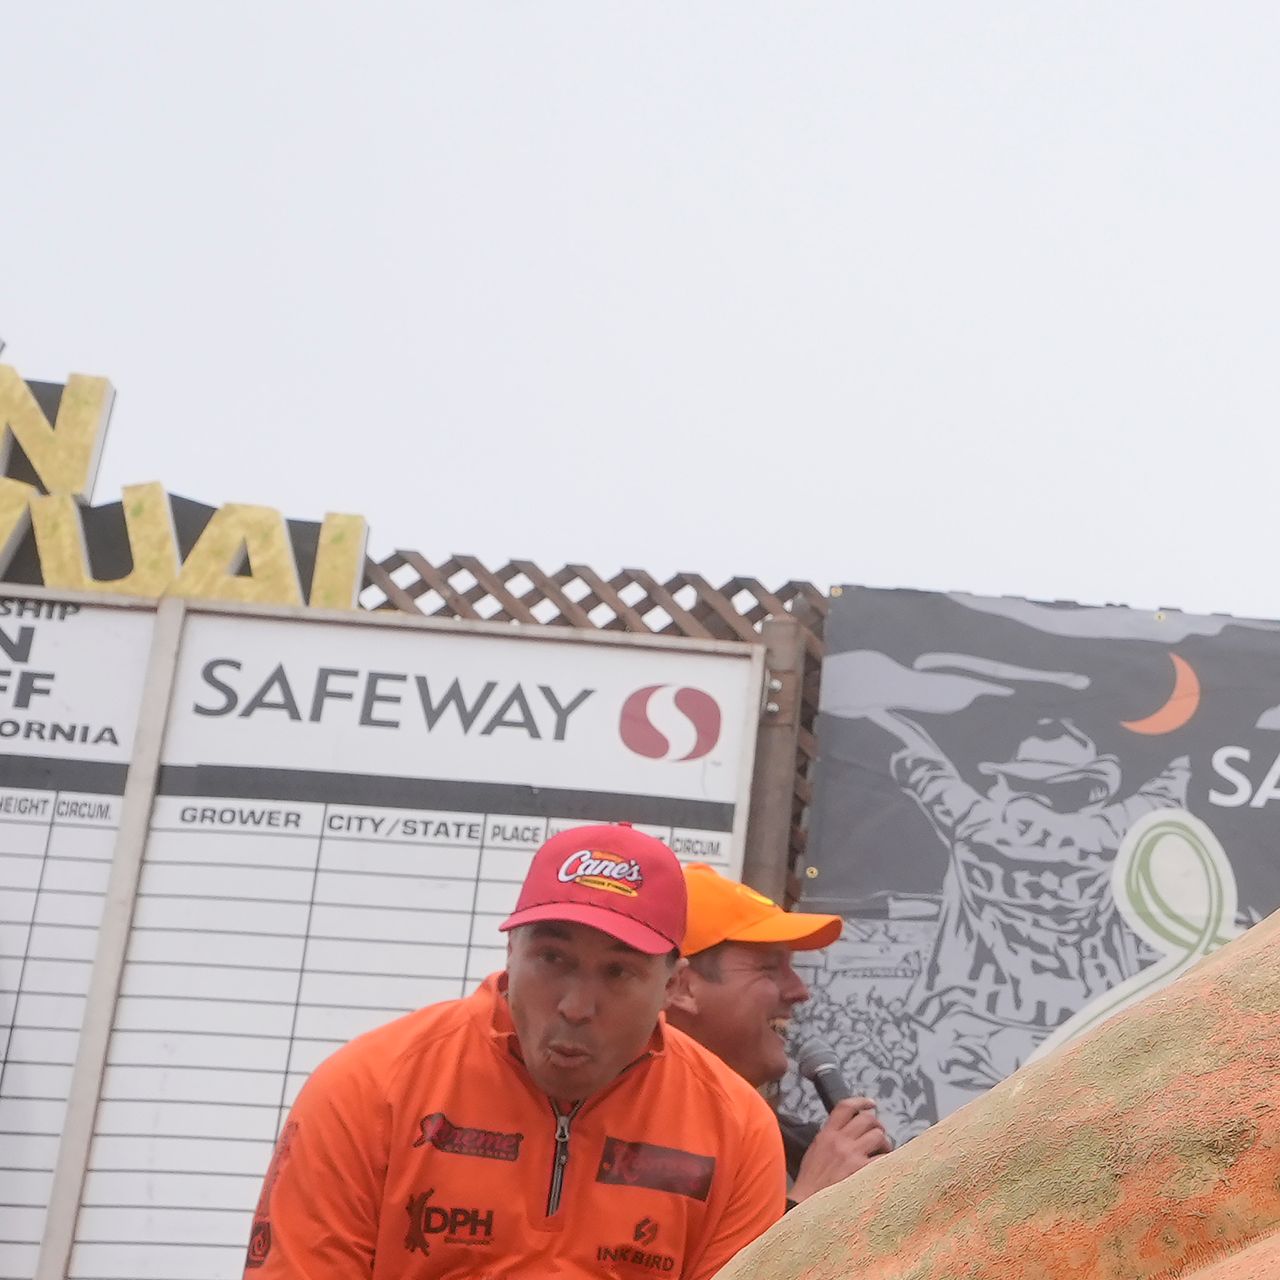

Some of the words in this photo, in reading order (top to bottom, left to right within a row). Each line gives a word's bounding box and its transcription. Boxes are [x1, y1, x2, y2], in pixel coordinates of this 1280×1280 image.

[193, 658, 597, 741] SAFEWAY
[0, 796, 49, 815] EIGHT
[180, 806, 301, 828] GROWER
[327, 815, 481, 840] CITY/STATE
[491, 824, 541, 843] PLACE
[557, 849, 643, 882] Cane's
[423, 1206, 495, 1237] DPH
[596, 1247, 675, 1272] INKBIRD
